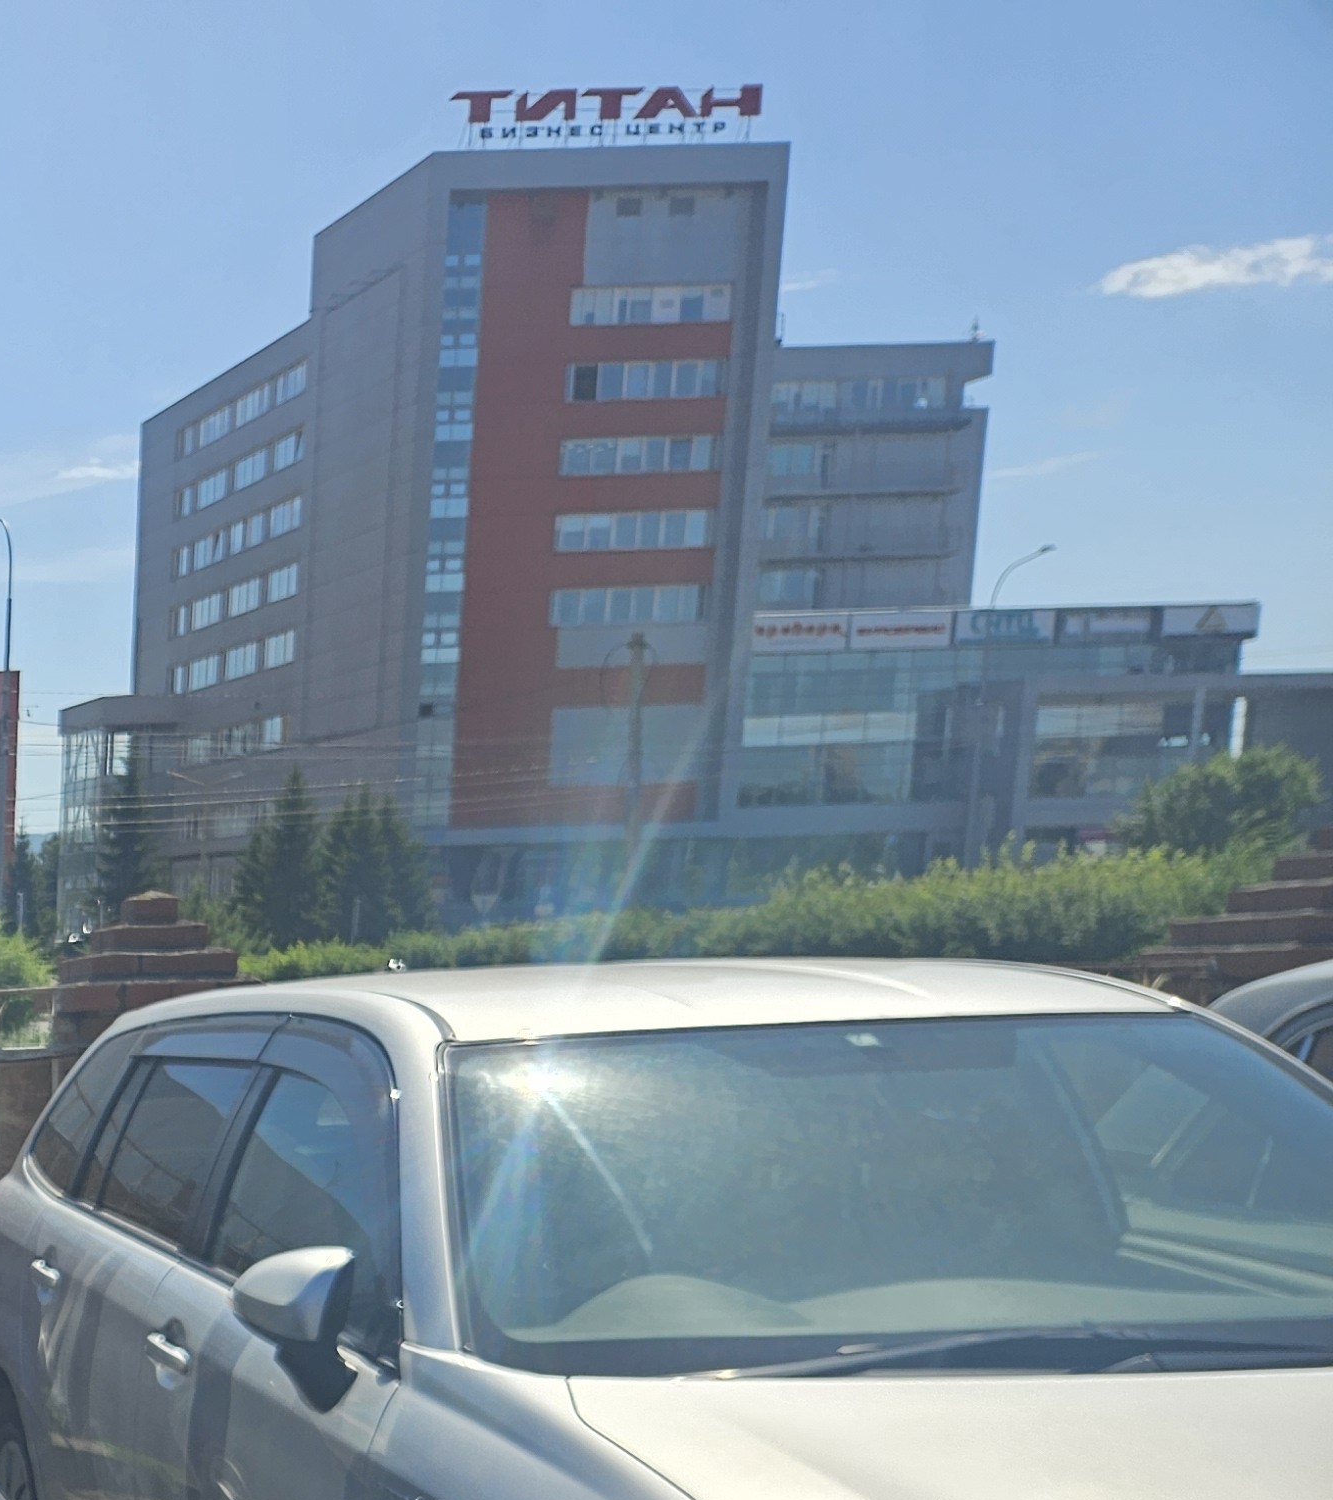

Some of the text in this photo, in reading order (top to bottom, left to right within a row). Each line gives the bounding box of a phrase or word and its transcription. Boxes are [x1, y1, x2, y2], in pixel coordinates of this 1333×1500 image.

[449, 84, 763, 123] ТИТАН
[479, 120, 727, 139] БИЗНЕС ЦЕНТР
